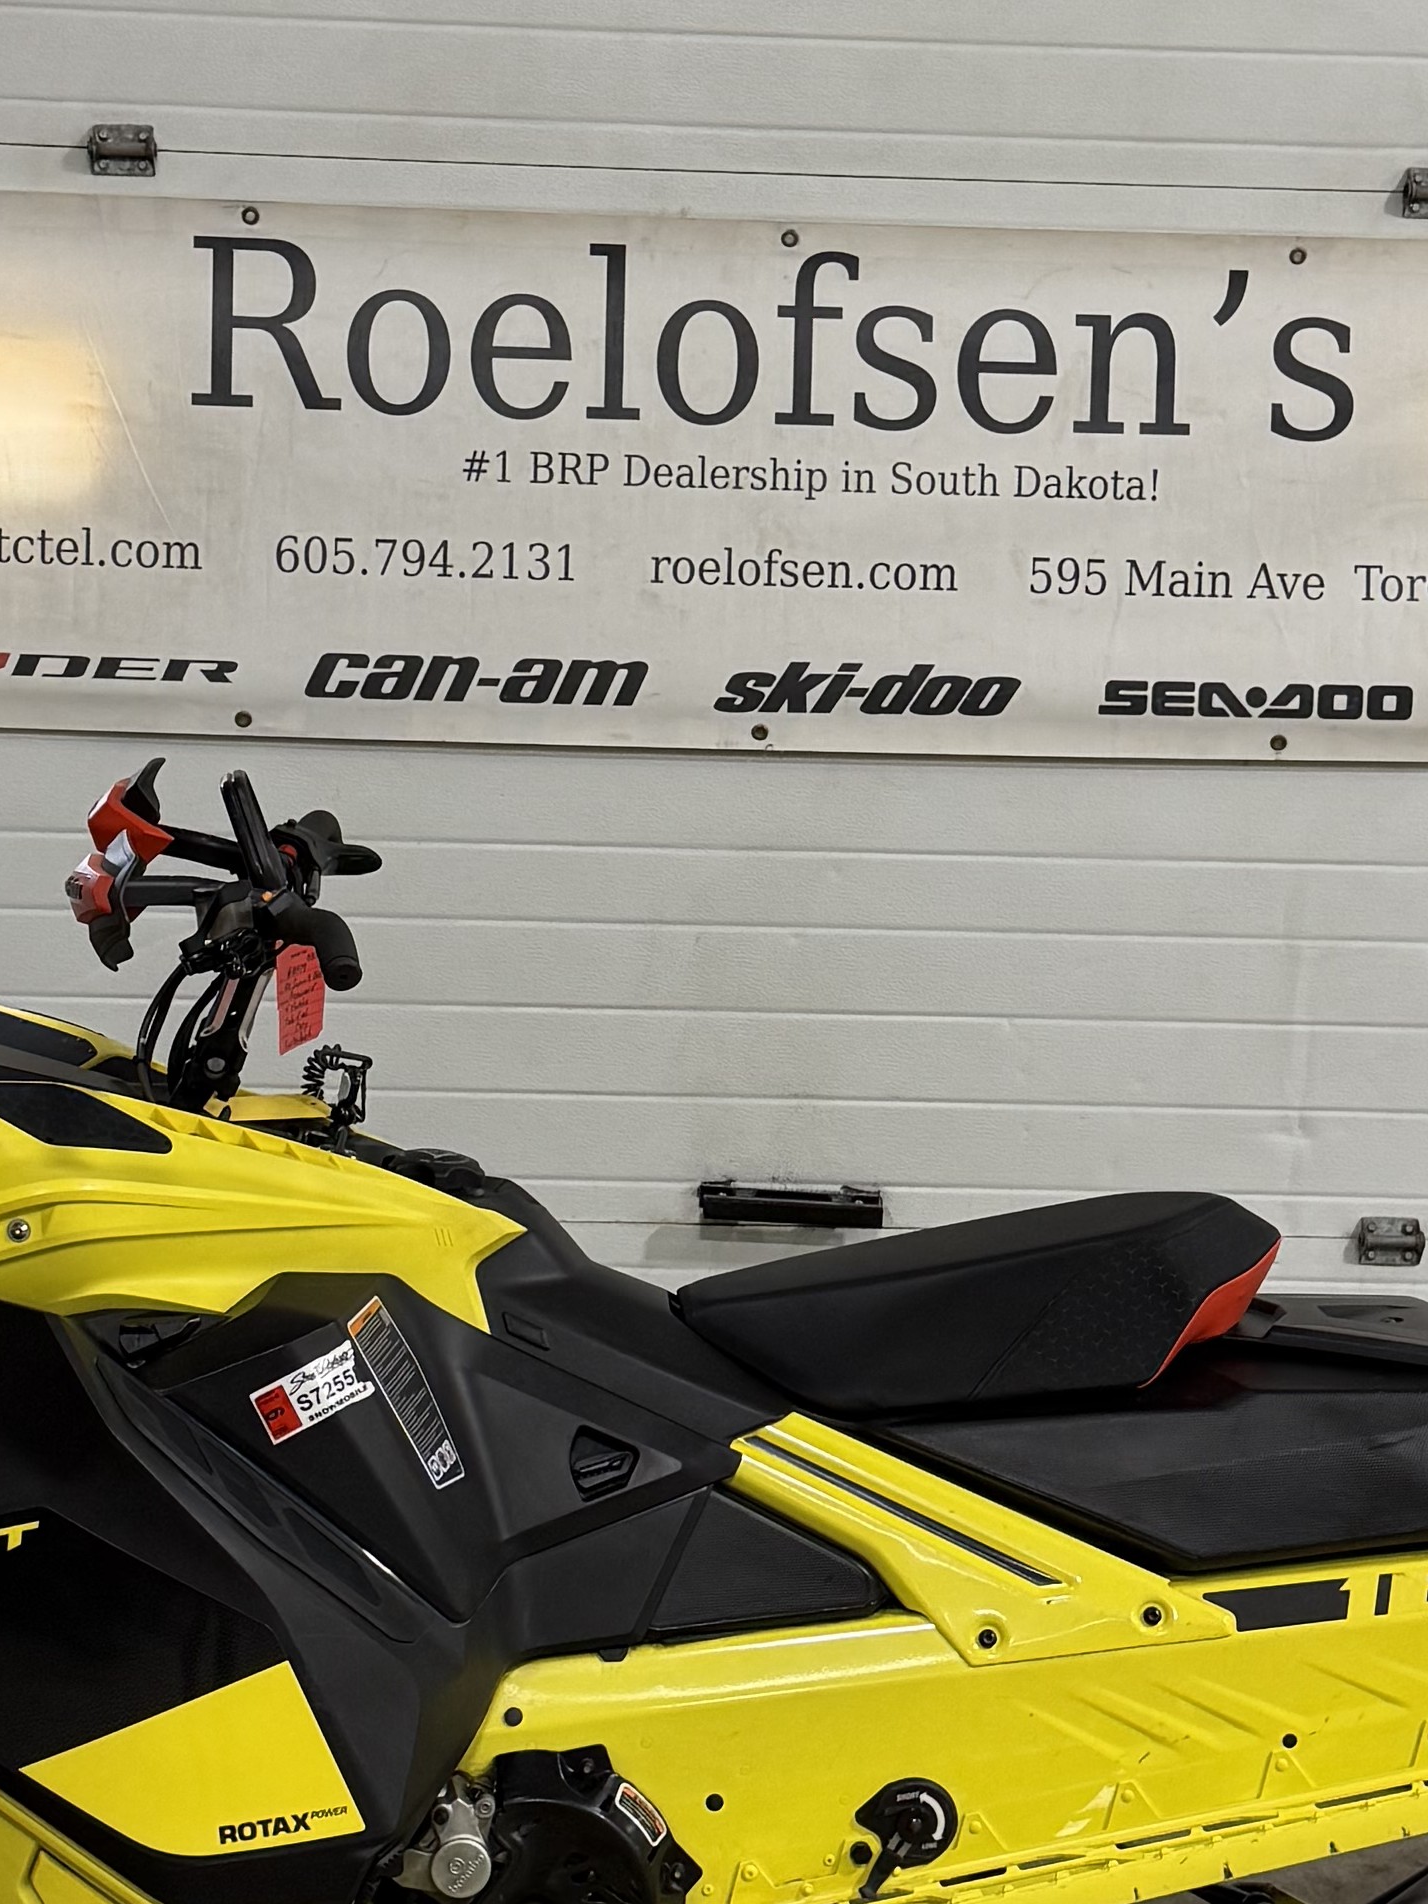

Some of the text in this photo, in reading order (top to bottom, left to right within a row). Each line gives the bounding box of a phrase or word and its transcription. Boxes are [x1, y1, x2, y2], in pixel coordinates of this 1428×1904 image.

[191, 235, 1355, 442] Roelofsen’s
[462, 449, 1160, 501] #1 BRP Dealership in South Dakota!
[275, 535, 575, 581] 605.794.2131
[650, 547, 958, 592] roelofsen.com
[1029, 556, 1108, 596] 595
[1125, 559, 1233, 599] Main
[1246, 562, 1325, 601] Ave
[304, 652, 649, 706] can-am
[713, 661, 1021, 716] ski-doo
[218, 1805, 348, 1845] ROTAX POWER
